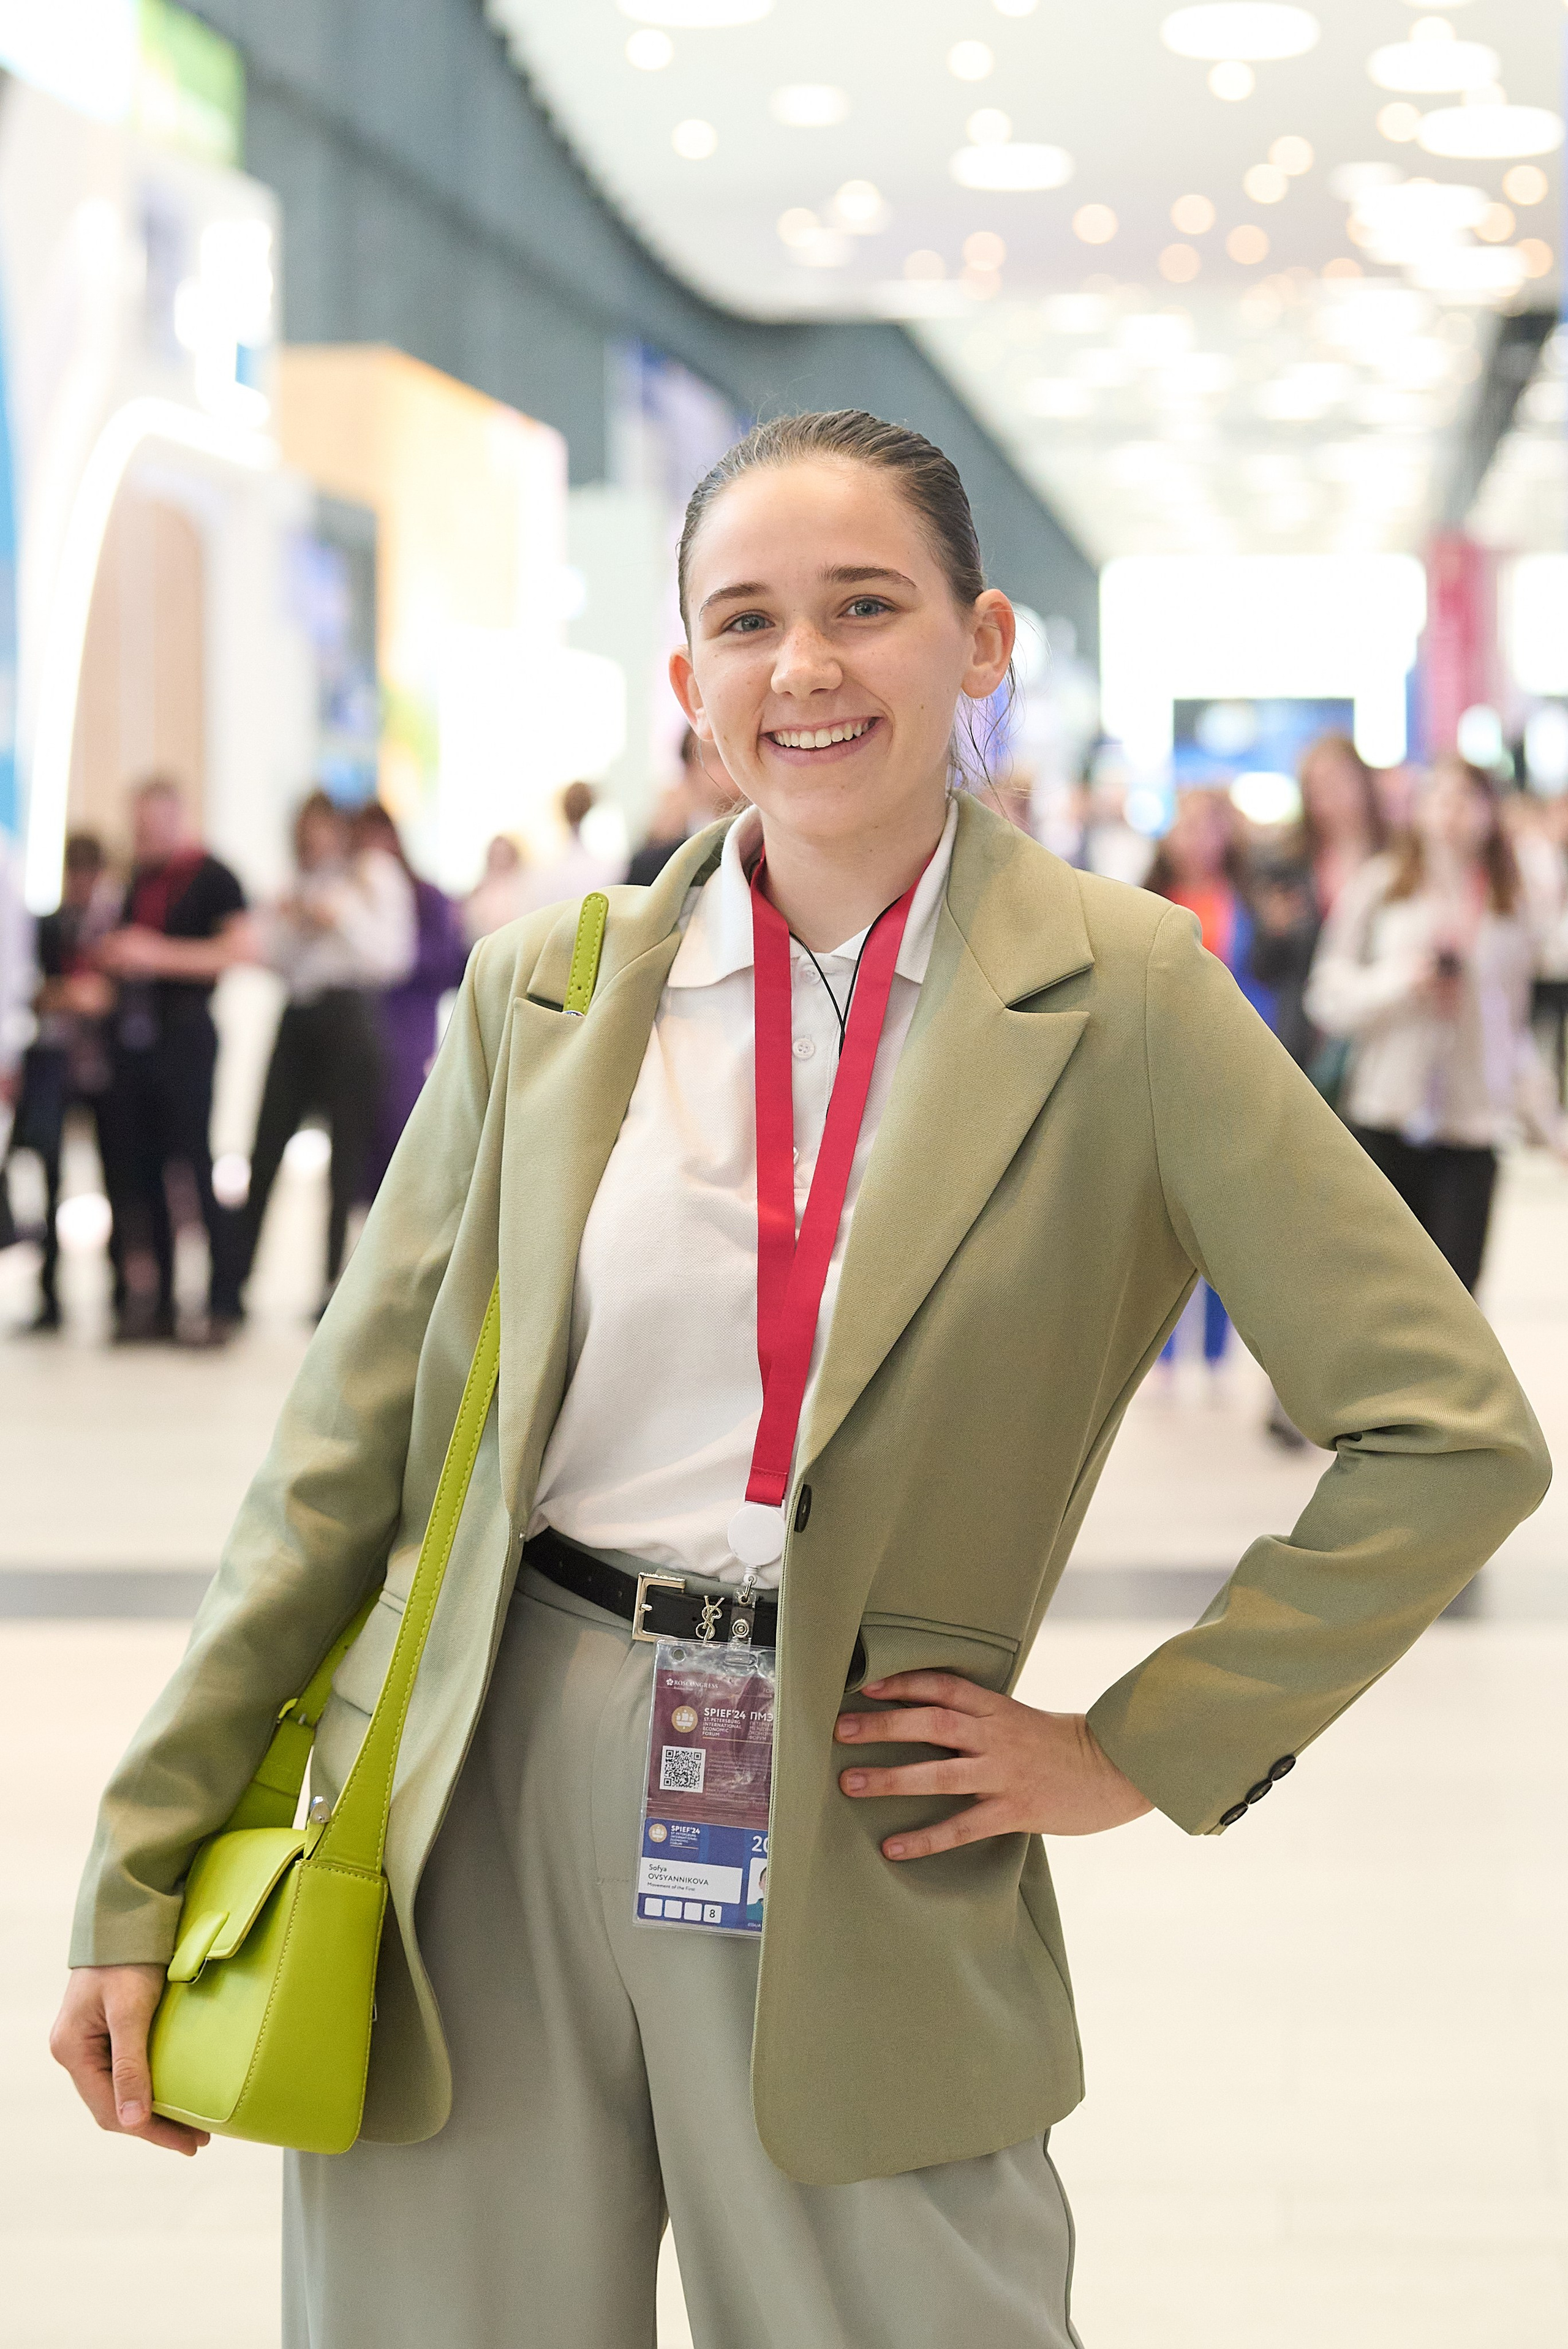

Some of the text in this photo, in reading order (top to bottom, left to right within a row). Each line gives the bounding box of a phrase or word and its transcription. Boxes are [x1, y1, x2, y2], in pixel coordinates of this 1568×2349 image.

[704, 1708, 746, 1719] SPIEF'24
[671, 1825, 701, 1834] SPIEF'24
[649, 1864, 667, 1872] Sofya
[648, 1873, 709, 1885] OVSYANNIKOVA
[709, 1909, 715, 1918] 8
